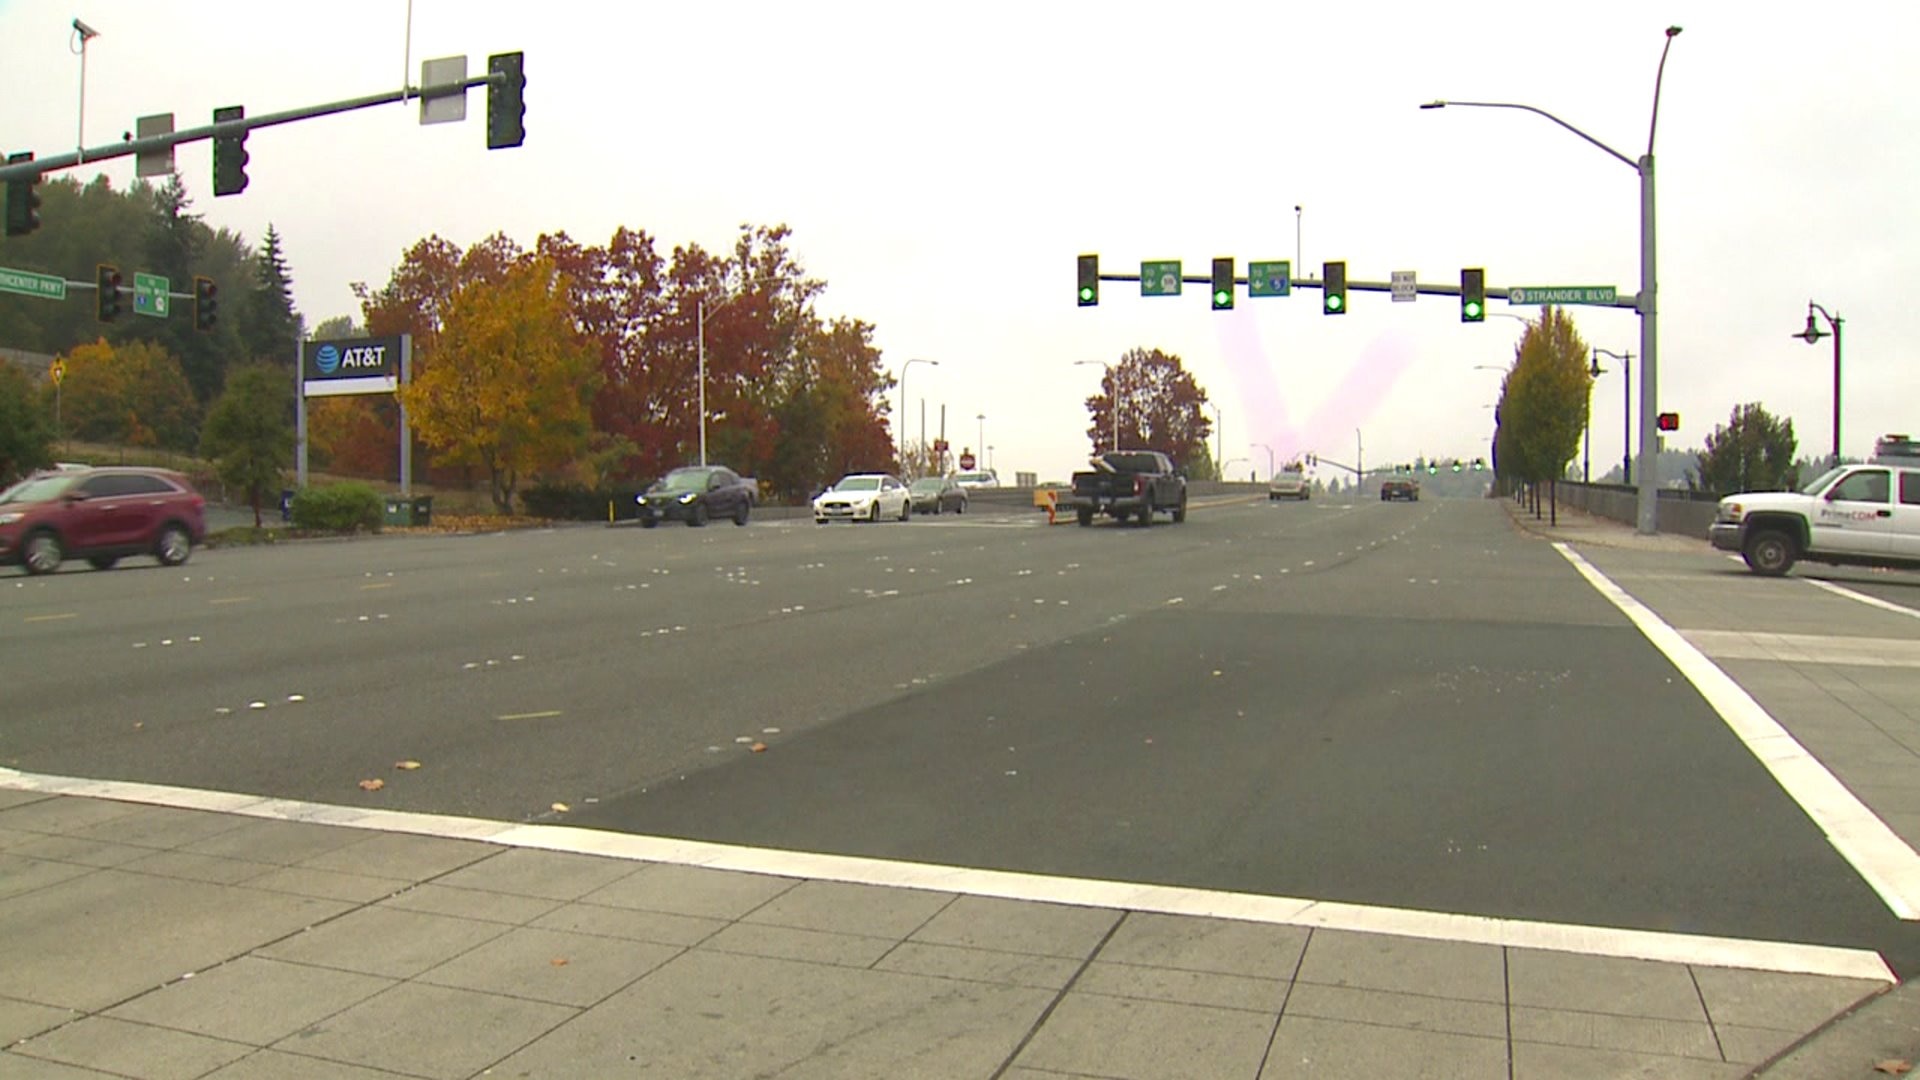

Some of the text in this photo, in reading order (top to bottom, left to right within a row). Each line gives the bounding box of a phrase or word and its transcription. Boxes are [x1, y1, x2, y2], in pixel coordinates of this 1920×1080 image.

[1526, 289, 1613, 302] STRANDER BLVD
[342, 346, 386, 368] AT&T
